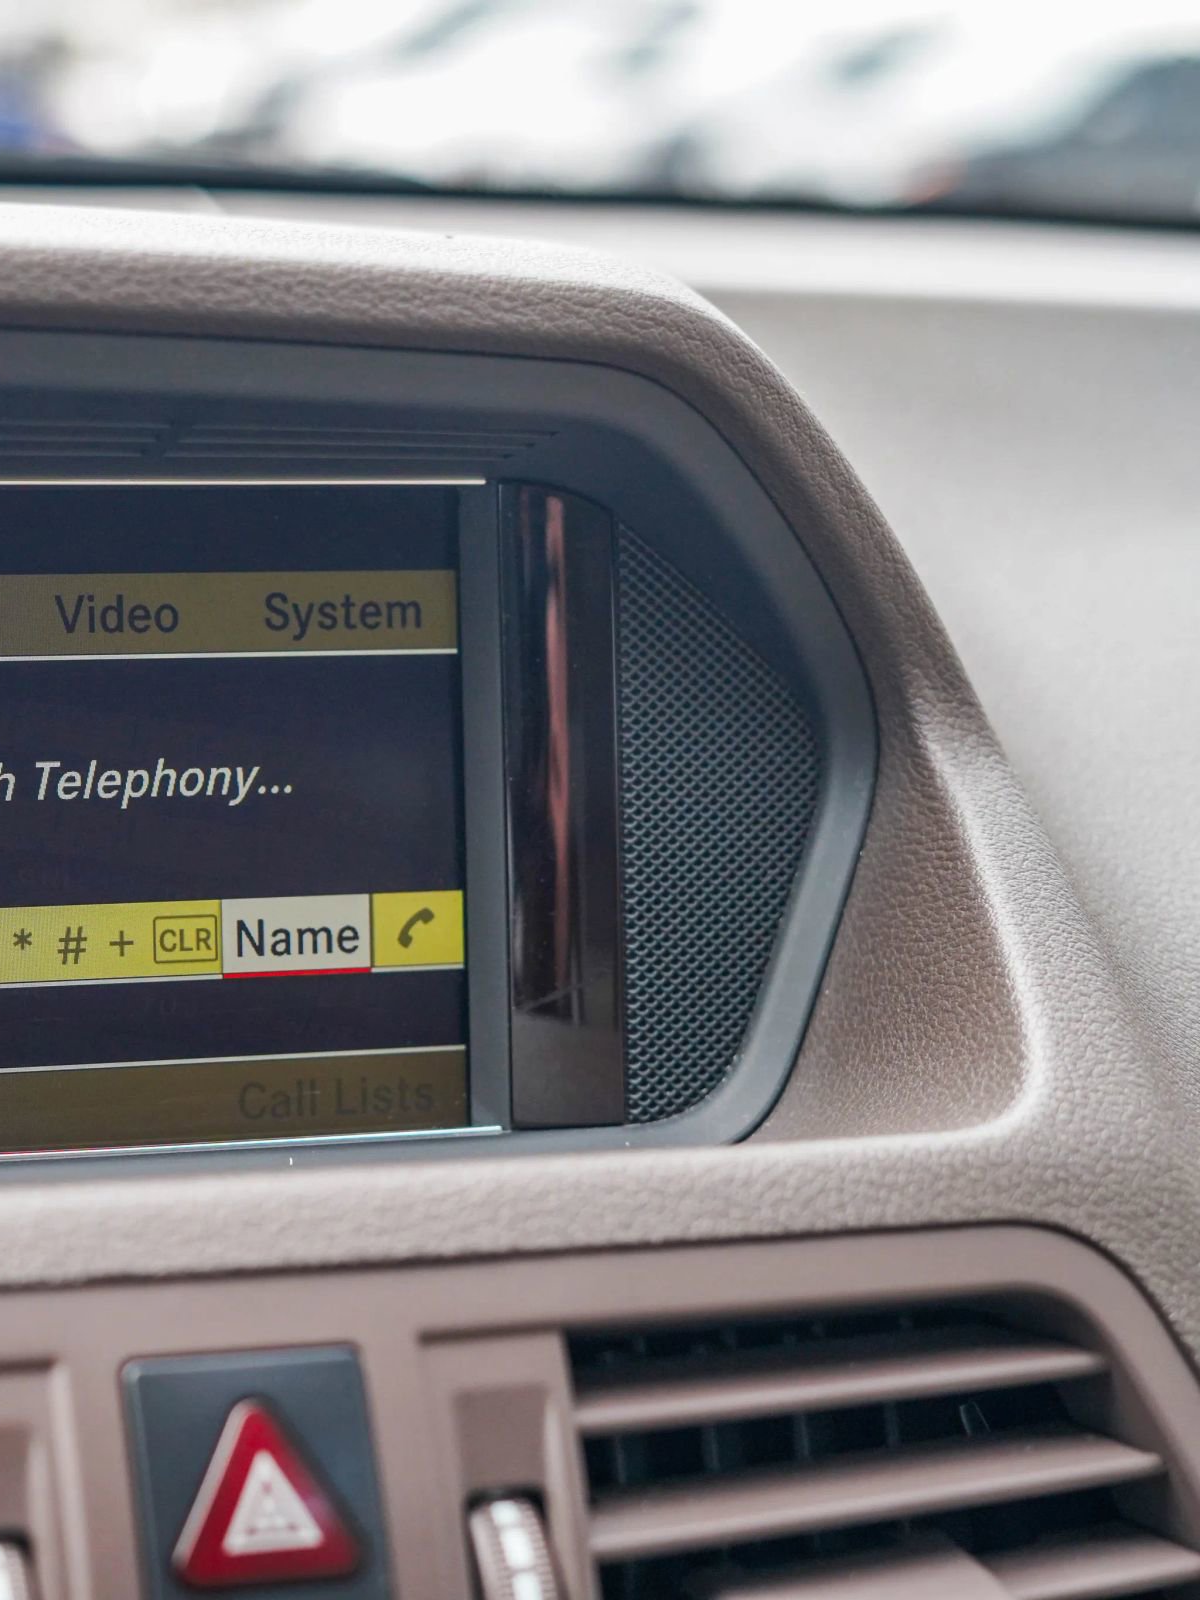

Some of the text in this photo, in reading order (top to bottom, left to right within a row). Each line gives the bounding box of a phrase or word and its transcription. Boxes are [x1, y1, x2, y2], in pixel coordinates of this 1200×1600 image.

[54, 594, 180, 634] Video
[264, 591, 423, 641] System
[34, 757, 293, 810] Telephony...
[57, 926, 89, 966] #
[108, 930, 135, 958] +
[158, 927, 213, 954] CLR
[236, 918, 361, 958] Name
[238, 1076, 434, 1121] Call Lists
